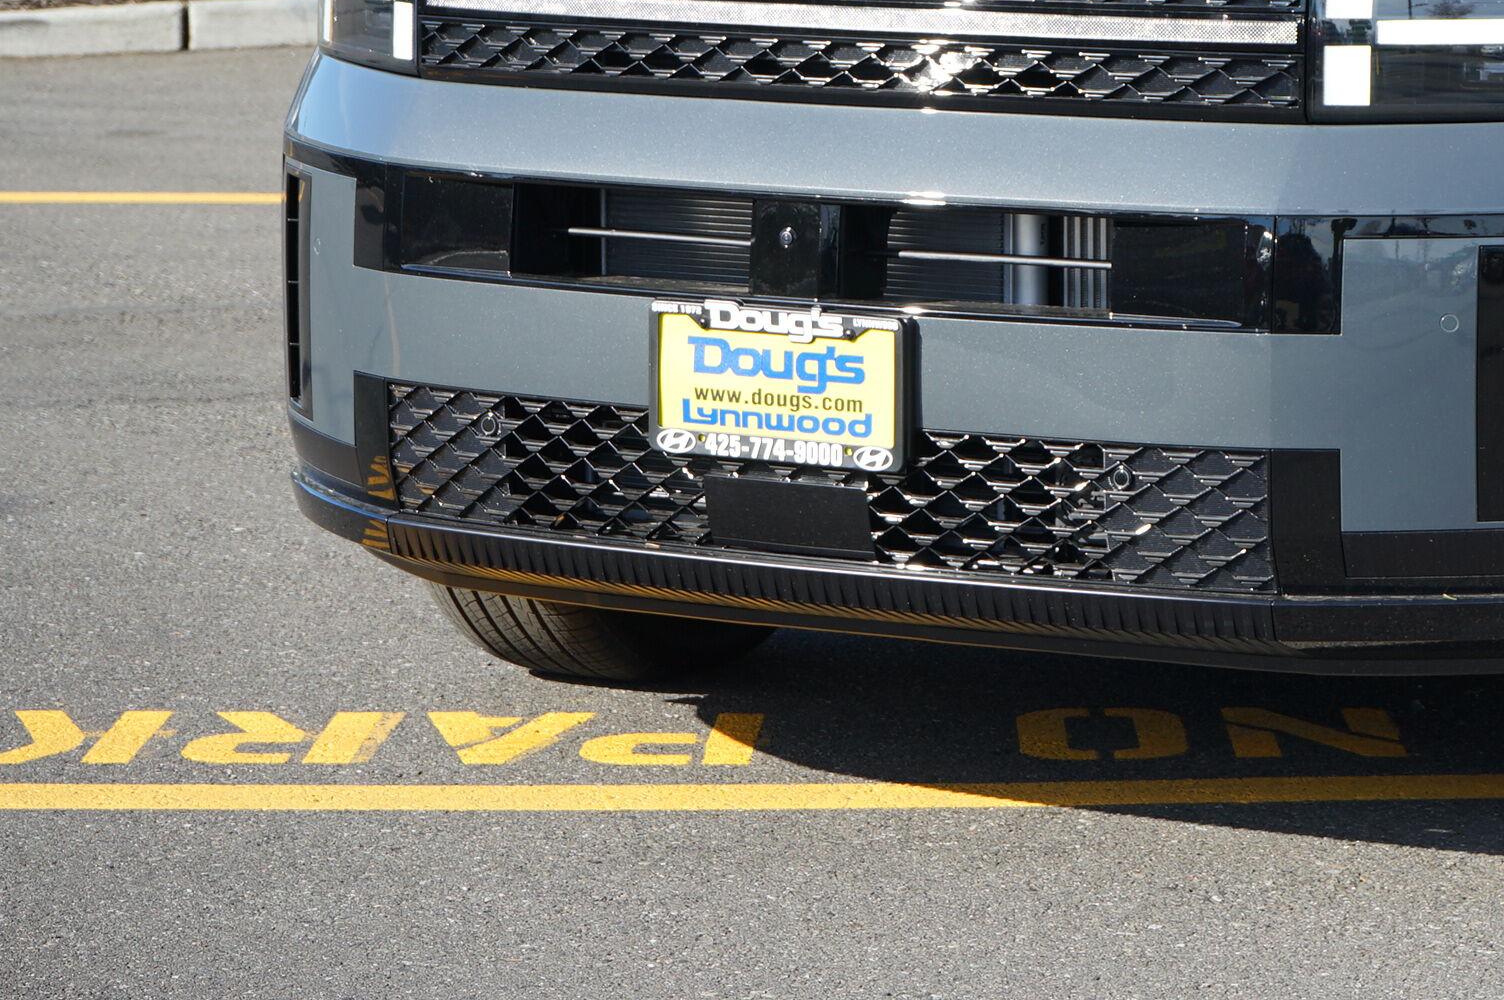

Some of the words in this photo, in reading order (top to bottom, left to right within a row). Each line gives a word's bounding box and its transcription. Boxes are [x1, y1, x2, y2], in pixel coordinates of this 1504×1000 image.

[704, 299, 843, 343] Doug's
[687, 335, 865, 394] Doug's
[682, 398, 873, 438] Lynnwood
[694, 386, 863, 413] www.dougs.com
[704, 433, 843, 467] 425-774-9000
[0, 710, 764, 766] PARK
[1015, 707, 1408, 761] NO
